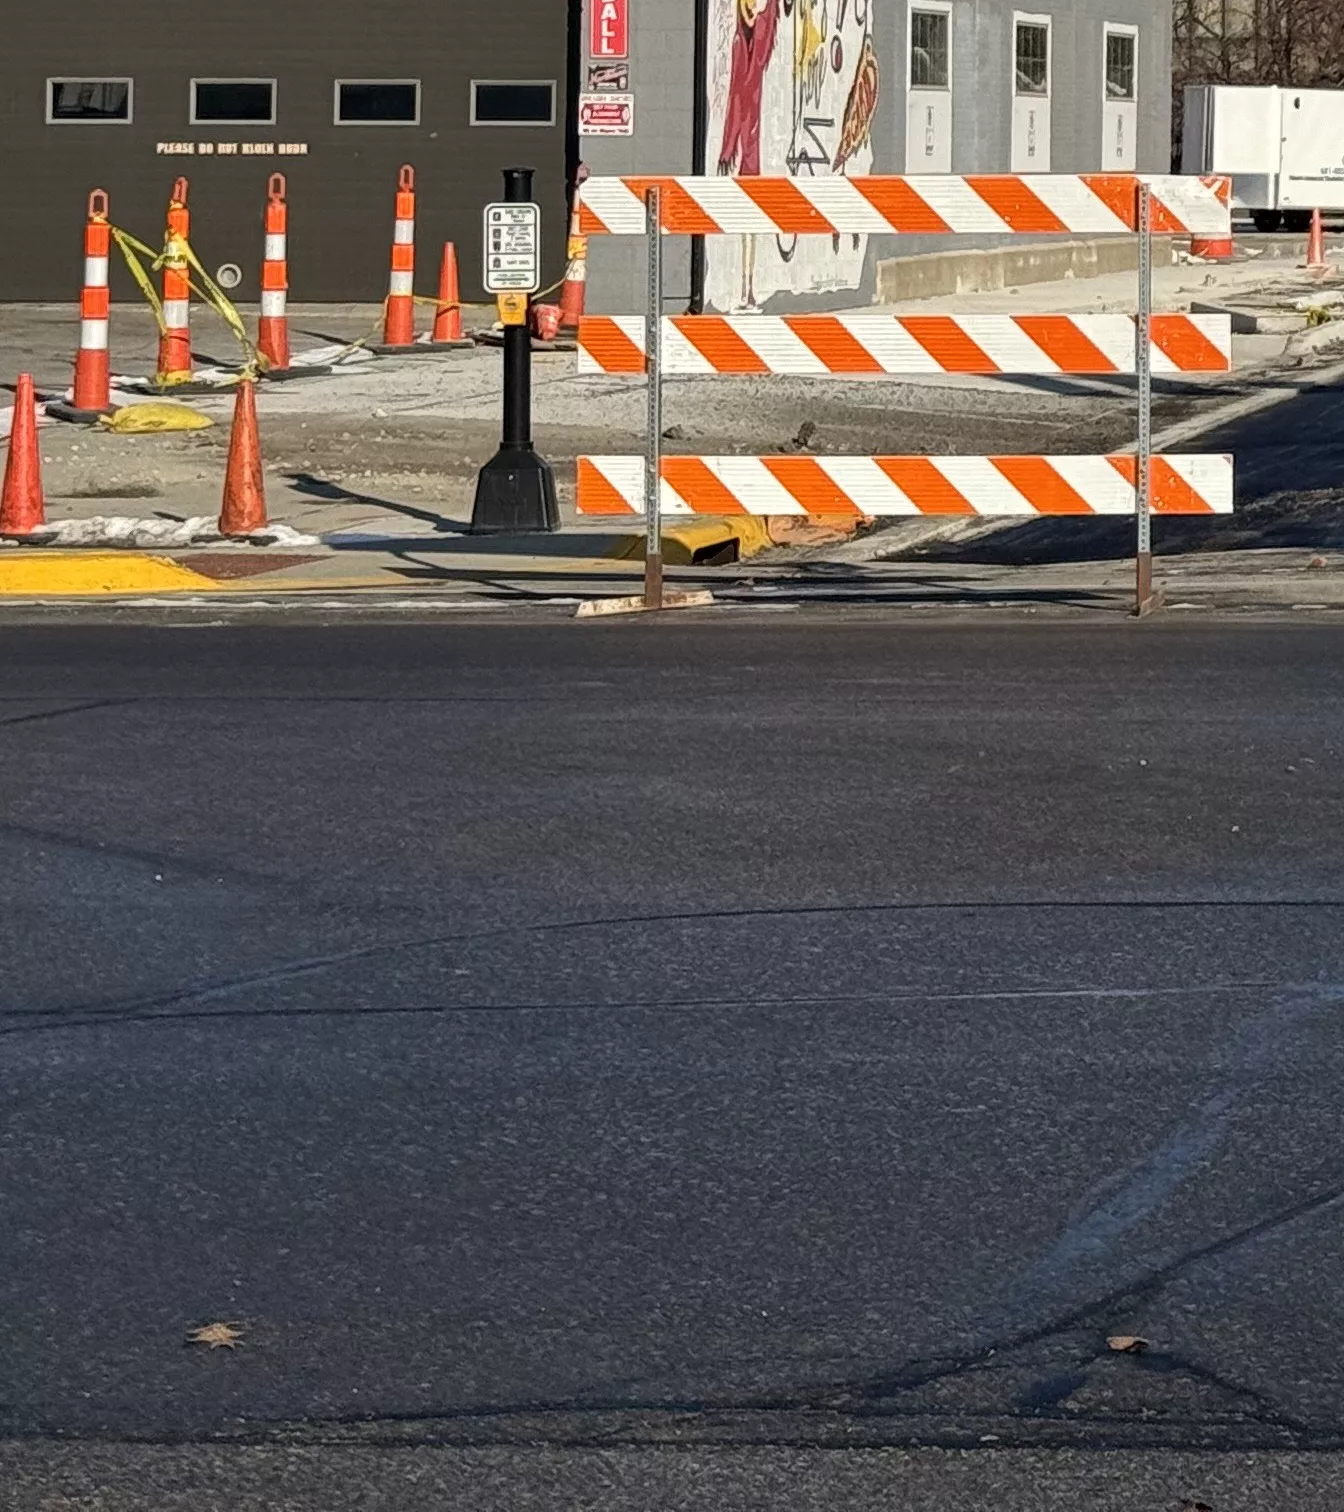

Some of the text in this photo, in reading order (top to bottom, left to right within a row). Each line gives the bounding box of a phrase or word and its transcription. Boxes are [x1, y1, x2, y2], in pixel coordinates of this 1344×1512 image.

[156, 143, 308, 155] PLEASE DO NOT BLOCK DOOR
